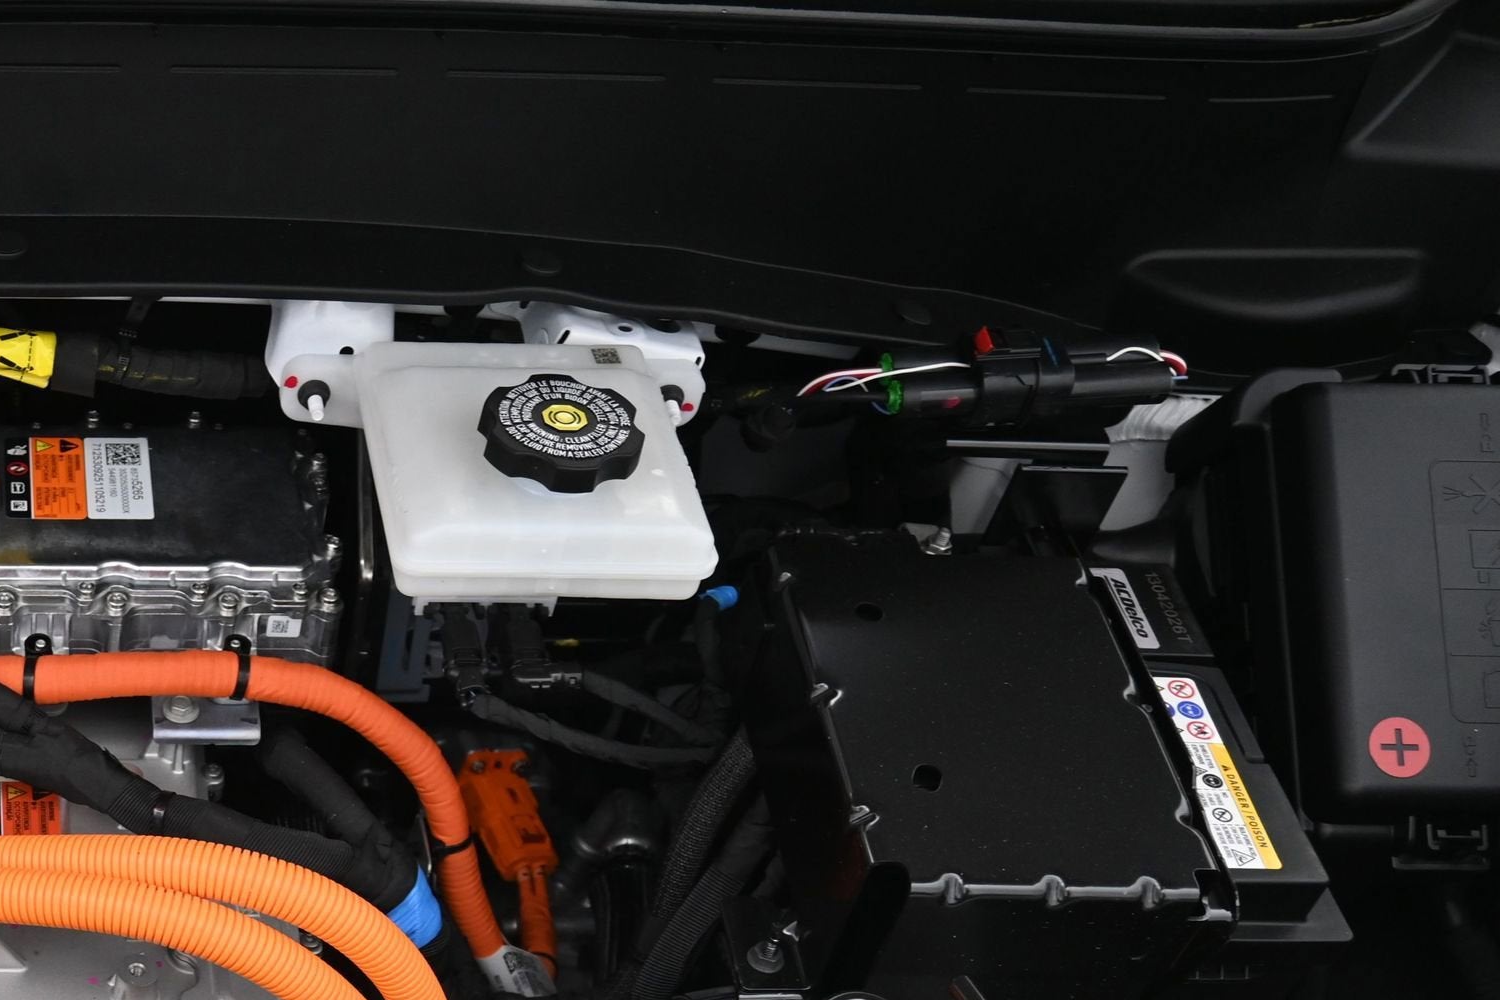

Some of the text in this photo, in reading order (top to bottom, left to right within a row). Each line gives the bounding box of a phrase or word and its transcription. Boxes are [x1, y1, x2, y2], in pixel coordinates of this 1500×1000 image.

[506, 381, 538, 399] NETTOYER
[550, 380, 587, 391] BOUCHON
[587, 387, 612, 402] AVANT
[609, 399, 620, 408] LA
[524, 389, 539, 398] QUE
[539, 386, 551, 394] DU
[553, 386, 581, 396] LIQUIDE
[583, 392, 595, 400] DE
[592, 399, 611, 413] FREIN
[521, 395, 545, 422] PROVENANT
[564, 394, 589, 406] BIDON
[516, 423, 531, 436] CAP
[529, 432, 556, 448] BEFORE
[596, 436, 609, 447] USE
[606, 424, 619, 440] ONLY
[527, 422, 560, 442] WARNING
[565, 434, 590, 444] CLEAN
[589, 424, 607, 440] FILLER
[520, 436, 543, 451] FLUID
[542, 446, 567, 457] FROM
[574, 447, 604, 458] SEALED
[1110, 577, 1148, 638] ACDelco
[1227, 774, 1249, 808] DANGER
[1247, 816, 1268, 848] POISON
